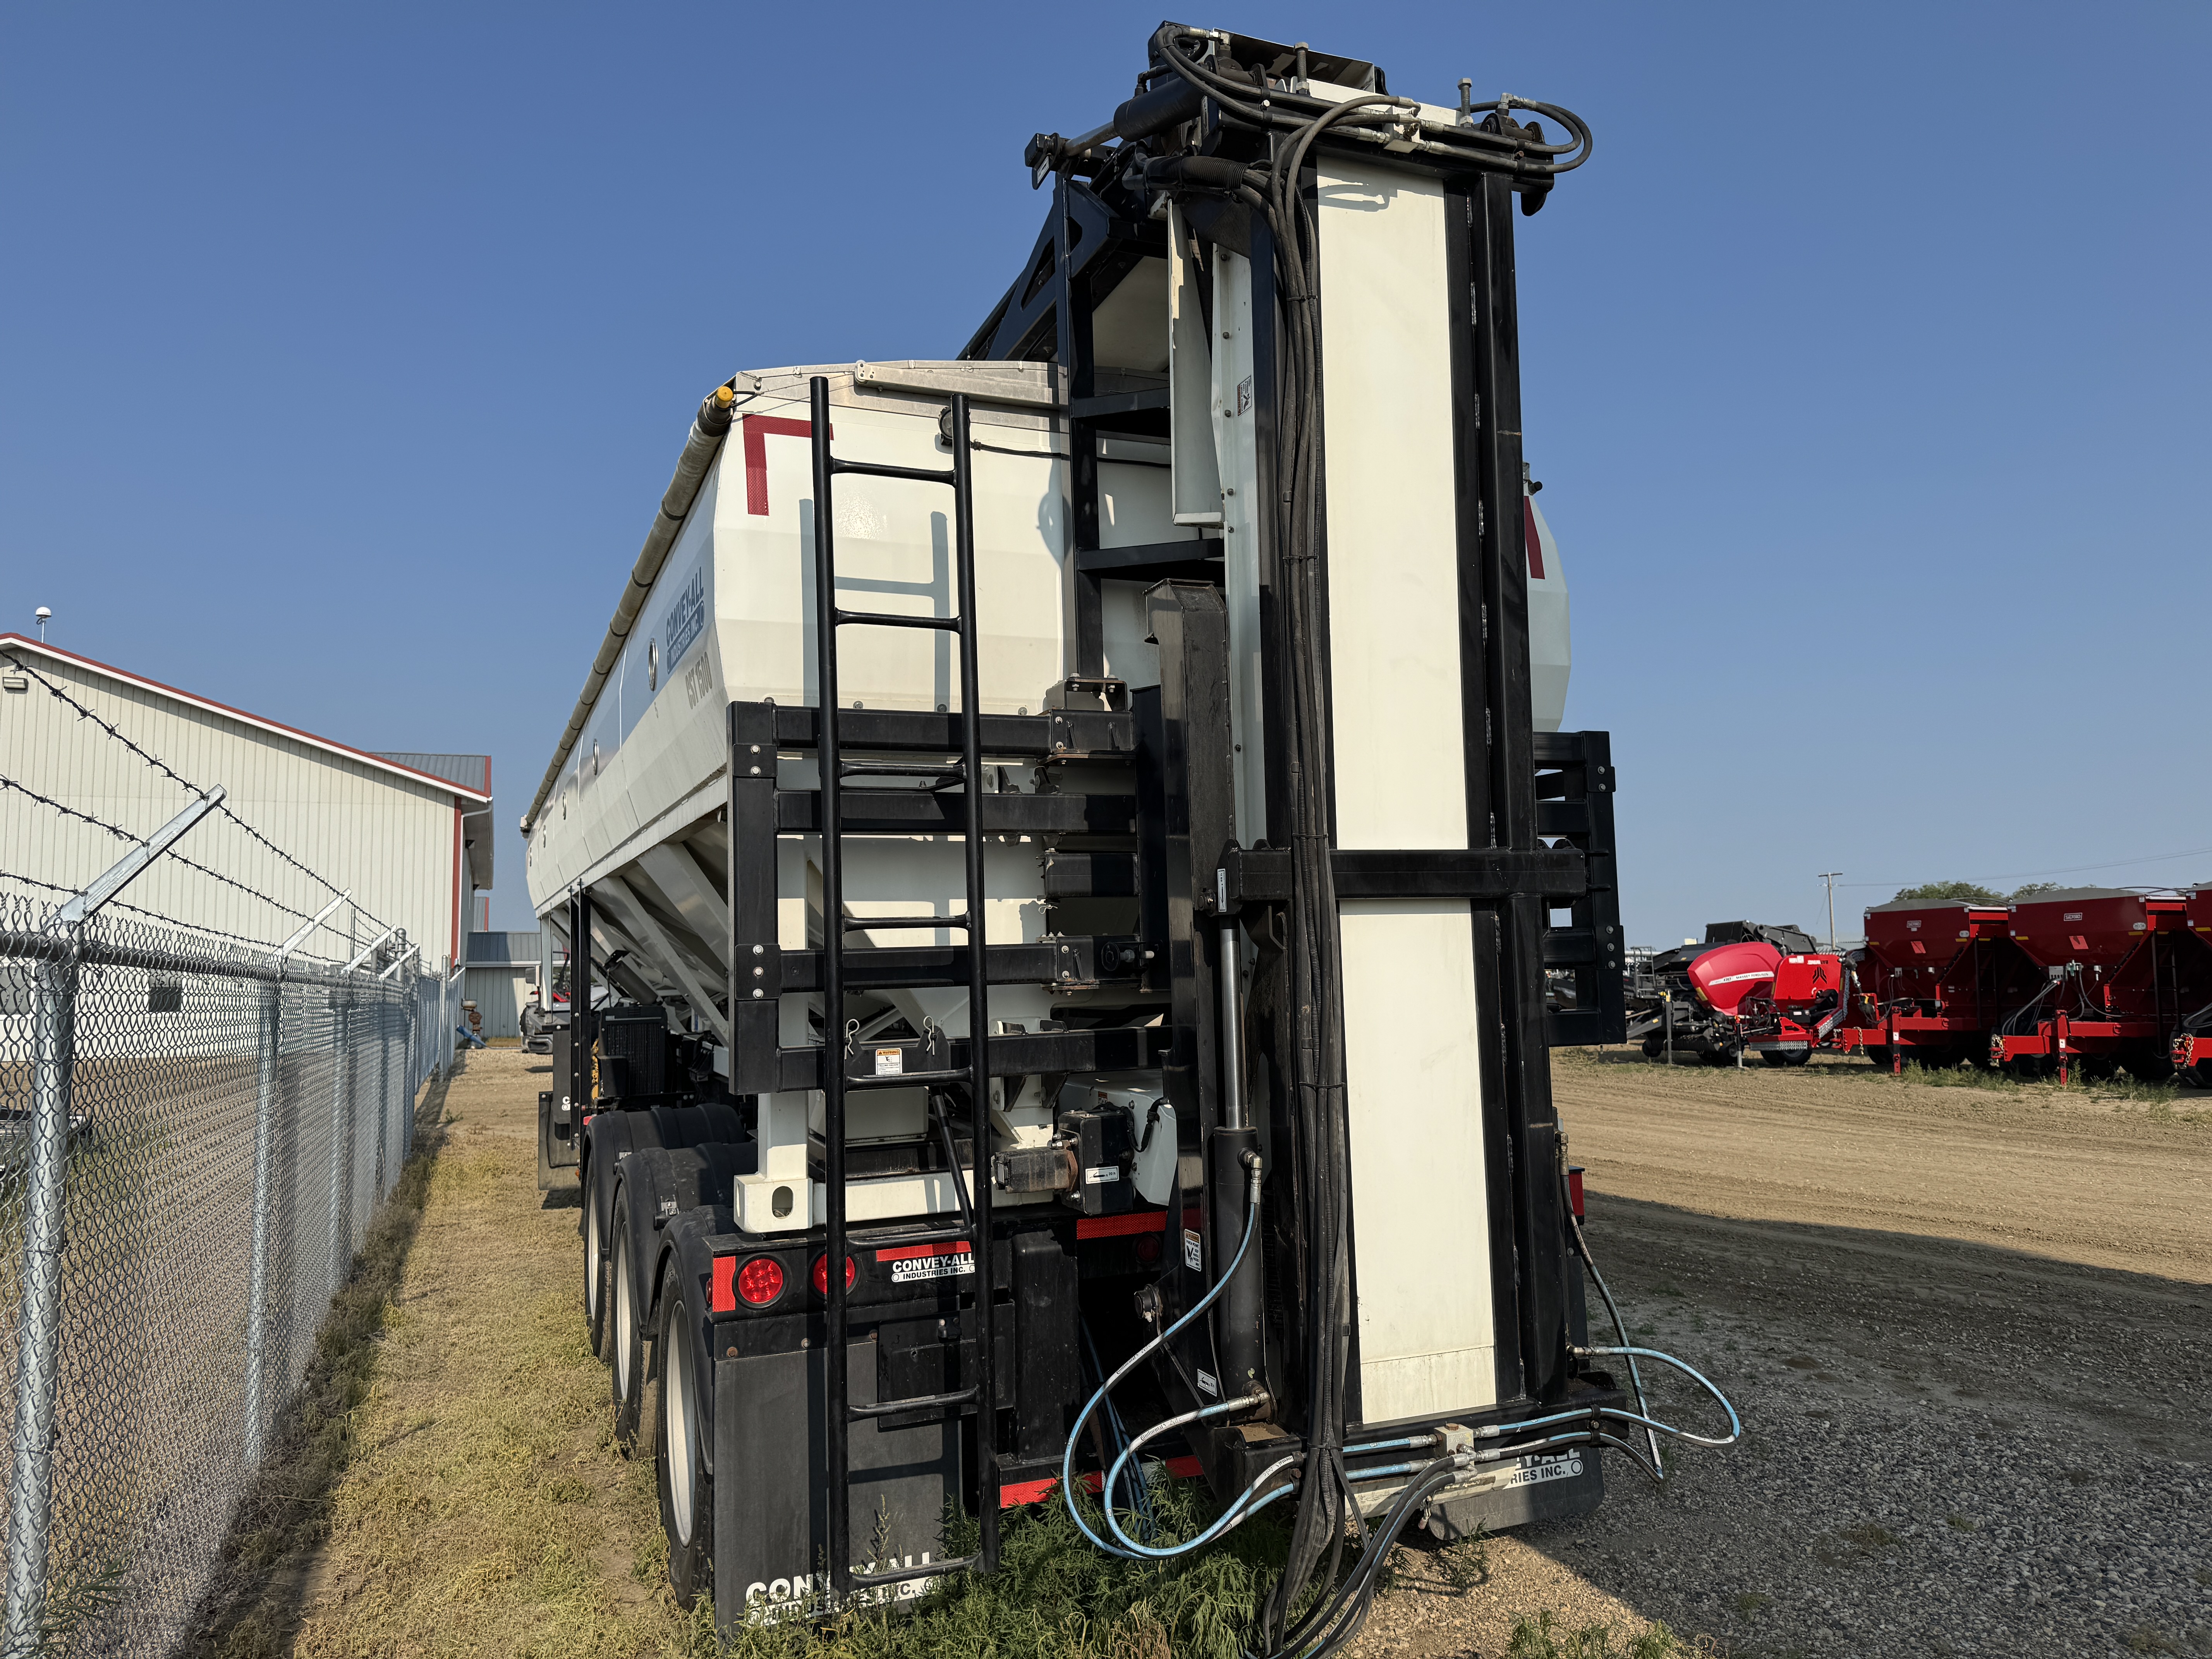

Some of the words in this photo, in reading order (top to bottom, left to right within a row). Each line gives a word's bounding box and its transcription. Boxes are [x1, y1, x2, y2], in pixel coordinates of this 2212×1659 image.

[670, 624, 690, 666] INDUSTRIES
[685, 667, 698, 710] CST
[696, 651, 713, 699] 1500
[892, 1252, 975, 1273] CONVEY-ALL
[903, 1268, 948, 1280] INDUSTRIES
[1541, 1465, 1566, 1479] INC.
